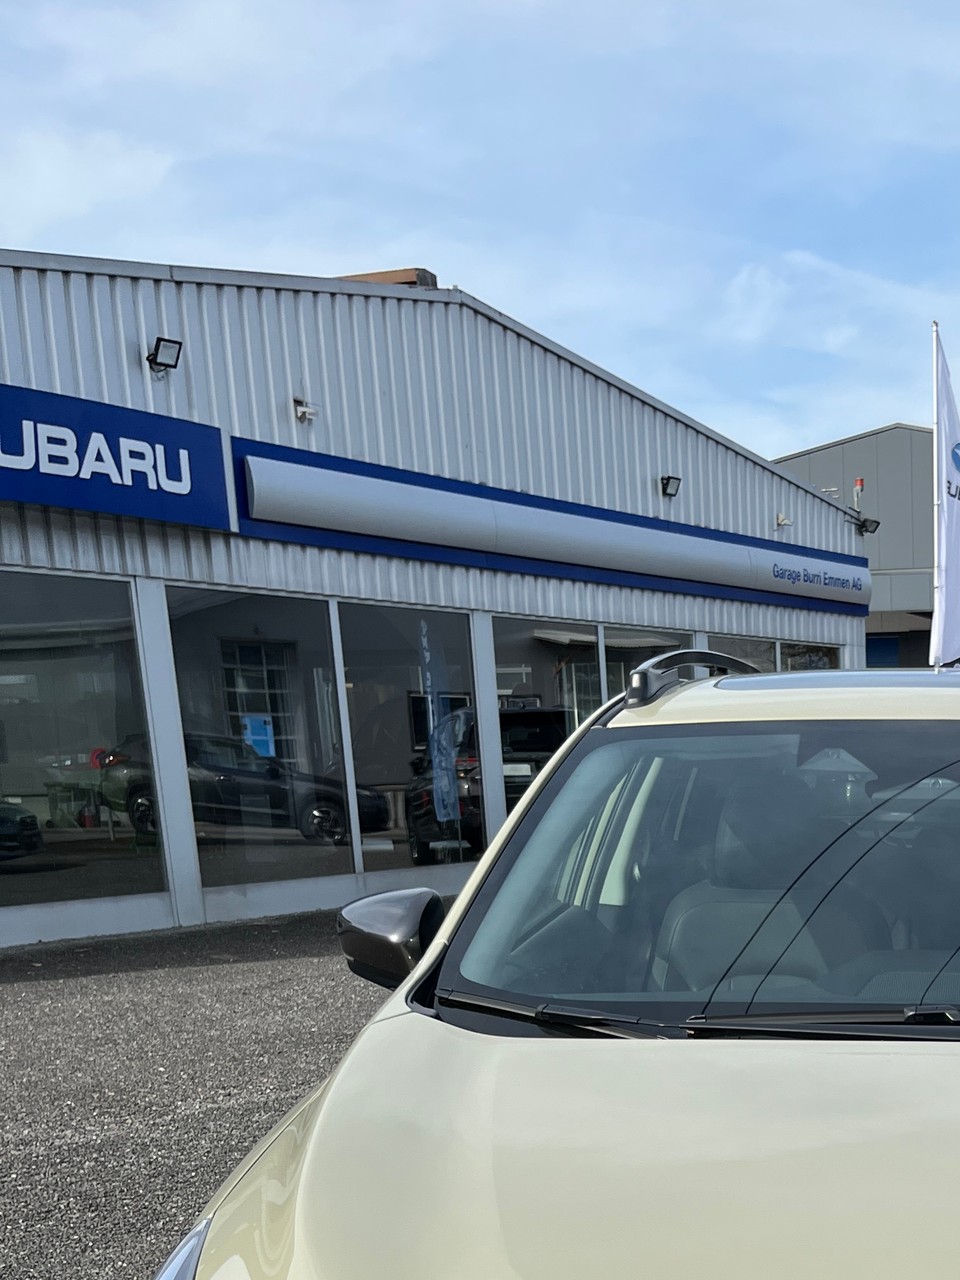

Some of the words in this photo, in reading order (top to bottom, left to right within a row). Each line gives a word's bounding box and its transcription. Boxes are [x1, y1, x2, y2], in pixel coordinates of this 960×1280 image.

[772, 563, 801, 585] Garage
[802, 568, 822, 585] Burri
[823, 571, 851, 590] Emmen
[851, 577, 862, 591] AG
